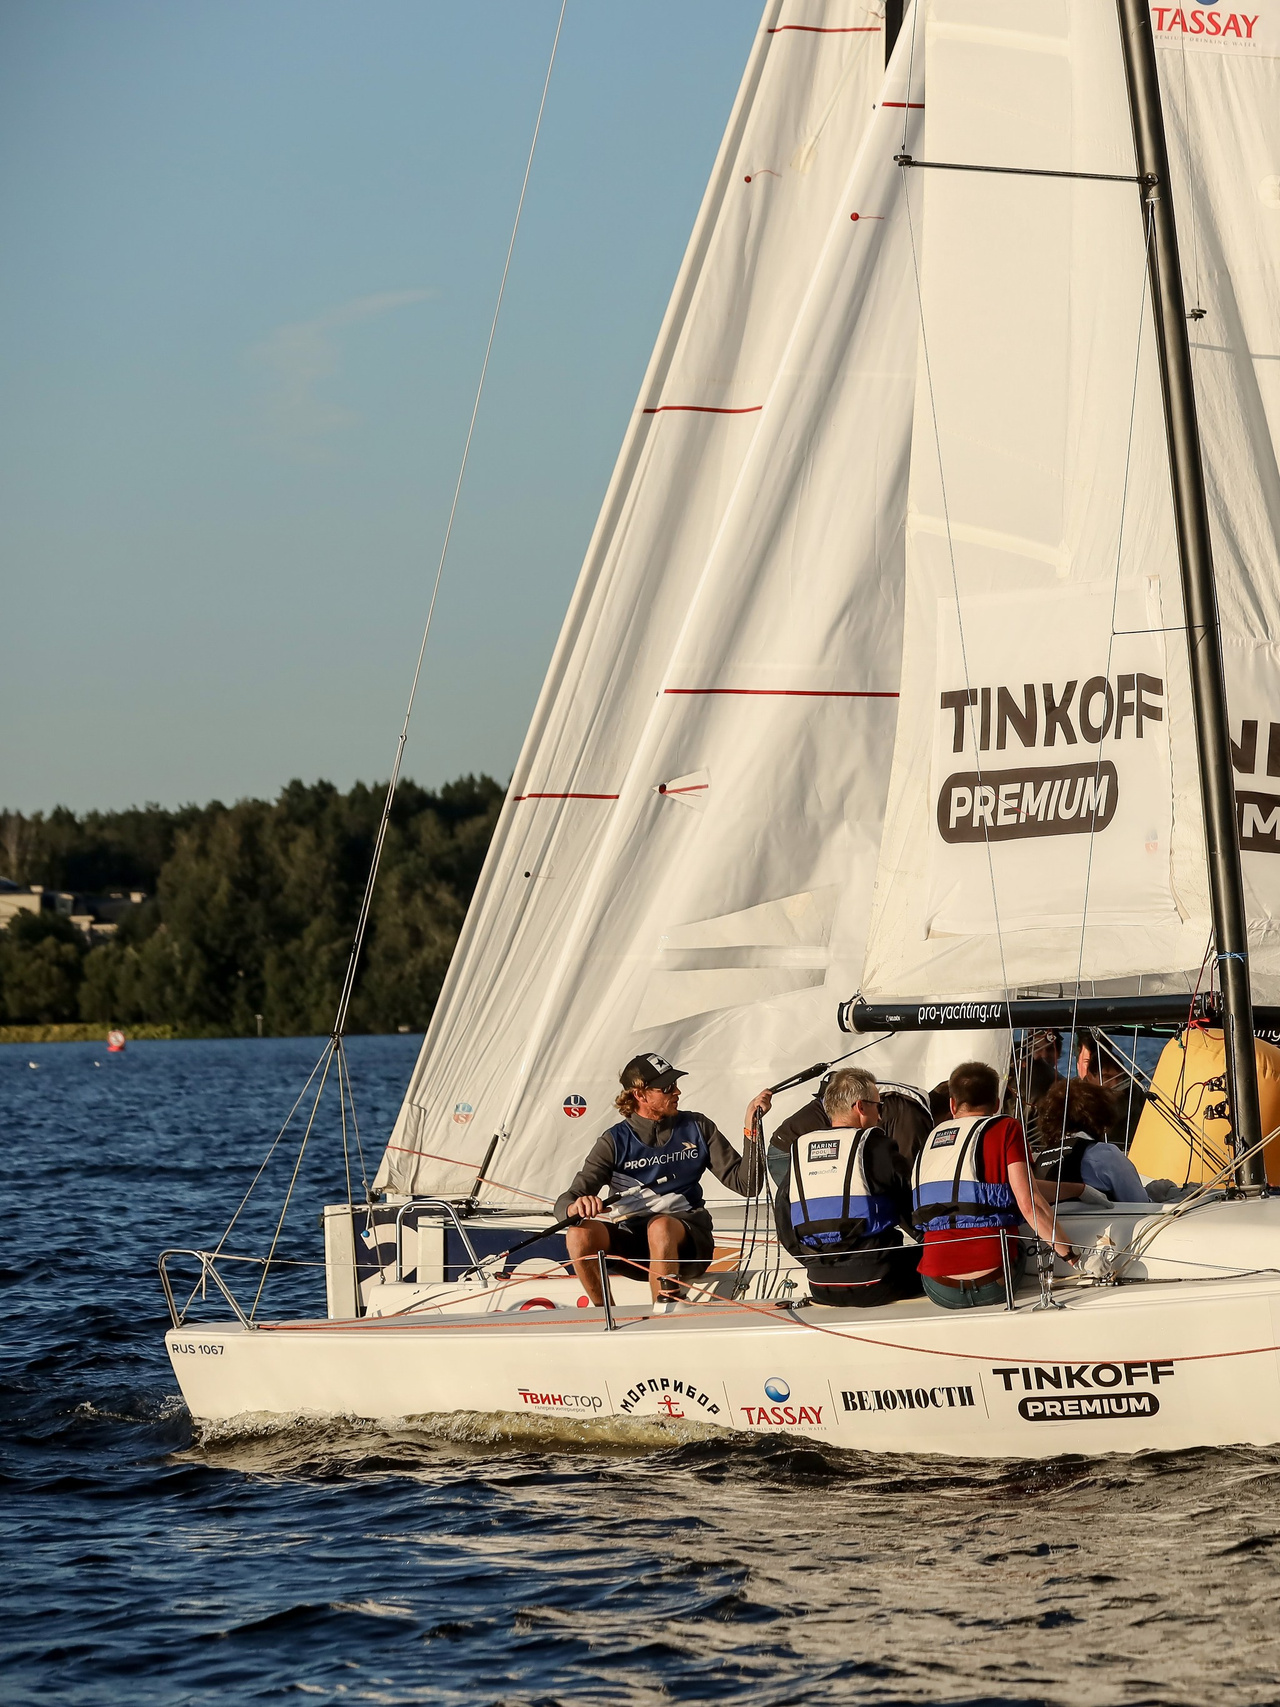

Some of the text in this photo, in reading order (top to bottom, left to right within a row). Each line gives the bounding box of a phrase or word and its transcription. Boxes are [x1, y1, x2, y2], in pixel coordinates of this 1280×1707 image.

[1151, 7, 1259, 38] TASSAY
[941, 673, 1163, 753] TINKOFF
[949, 775, 1110, 829] PREMIUM
[918, 1002, 1001, 1024] pro-yachting.ru
[624, 1149, 698, 1171] PROYACHTING
[172, 1344, 224, 1355] RUS 1067
[993, 1361, 1174, 1391] TINKOFF
[620, 1378, 721, 1415] МОРПРИБОР
[841, 1386, 976, 1413] ВЕДОМОСТИ
[1027, 1397, 1151, 1417] PREMIUM
[740, 1406, 823, 1425] TASSAY
